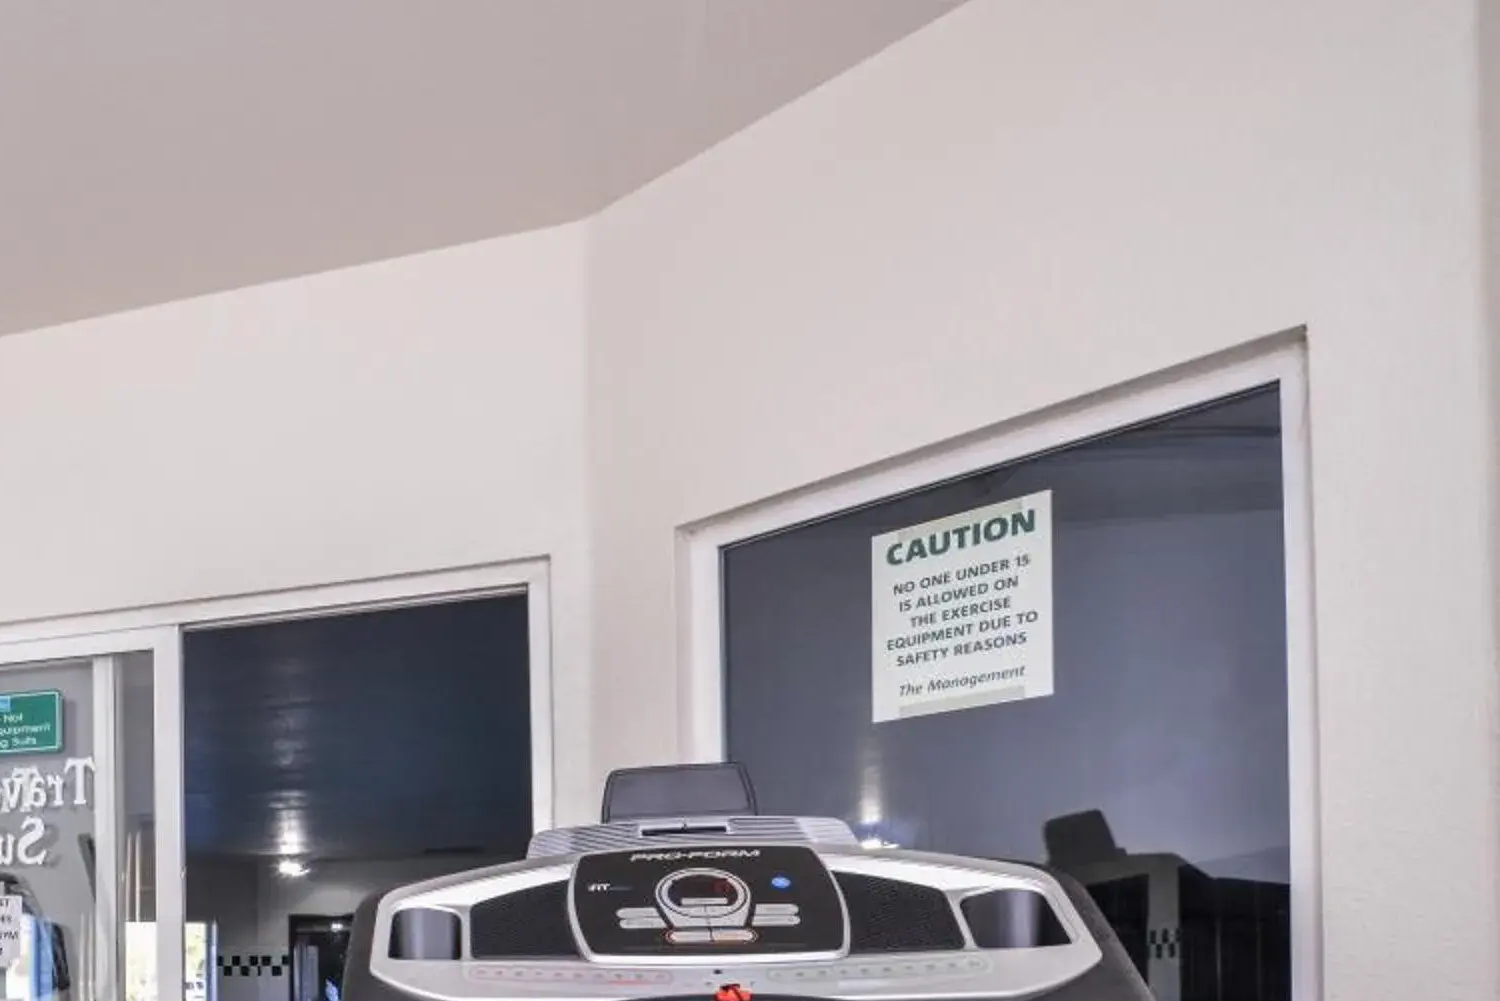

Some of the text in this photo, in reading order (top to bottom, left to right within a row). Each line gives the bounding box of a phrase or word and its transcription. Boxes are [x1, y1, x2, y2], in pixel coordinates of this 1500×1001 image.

[886, 509, 1035, 565] CAUTION
[893, 581, 915, 596] NO
[920, 571, 951, 589] ONE
[956, 556, 1010, 581] UNDER
[899, 576, 1019, 612] IS ALLOWED ON
[911, 596, 1011, 628] THE EXERCISE
[887, 611, 1038, 650] EQUIPMENT DUE TO
[897, 632, 1027, 667] SAFETY REASONS
[900, 665, 1026, 696] The Management
